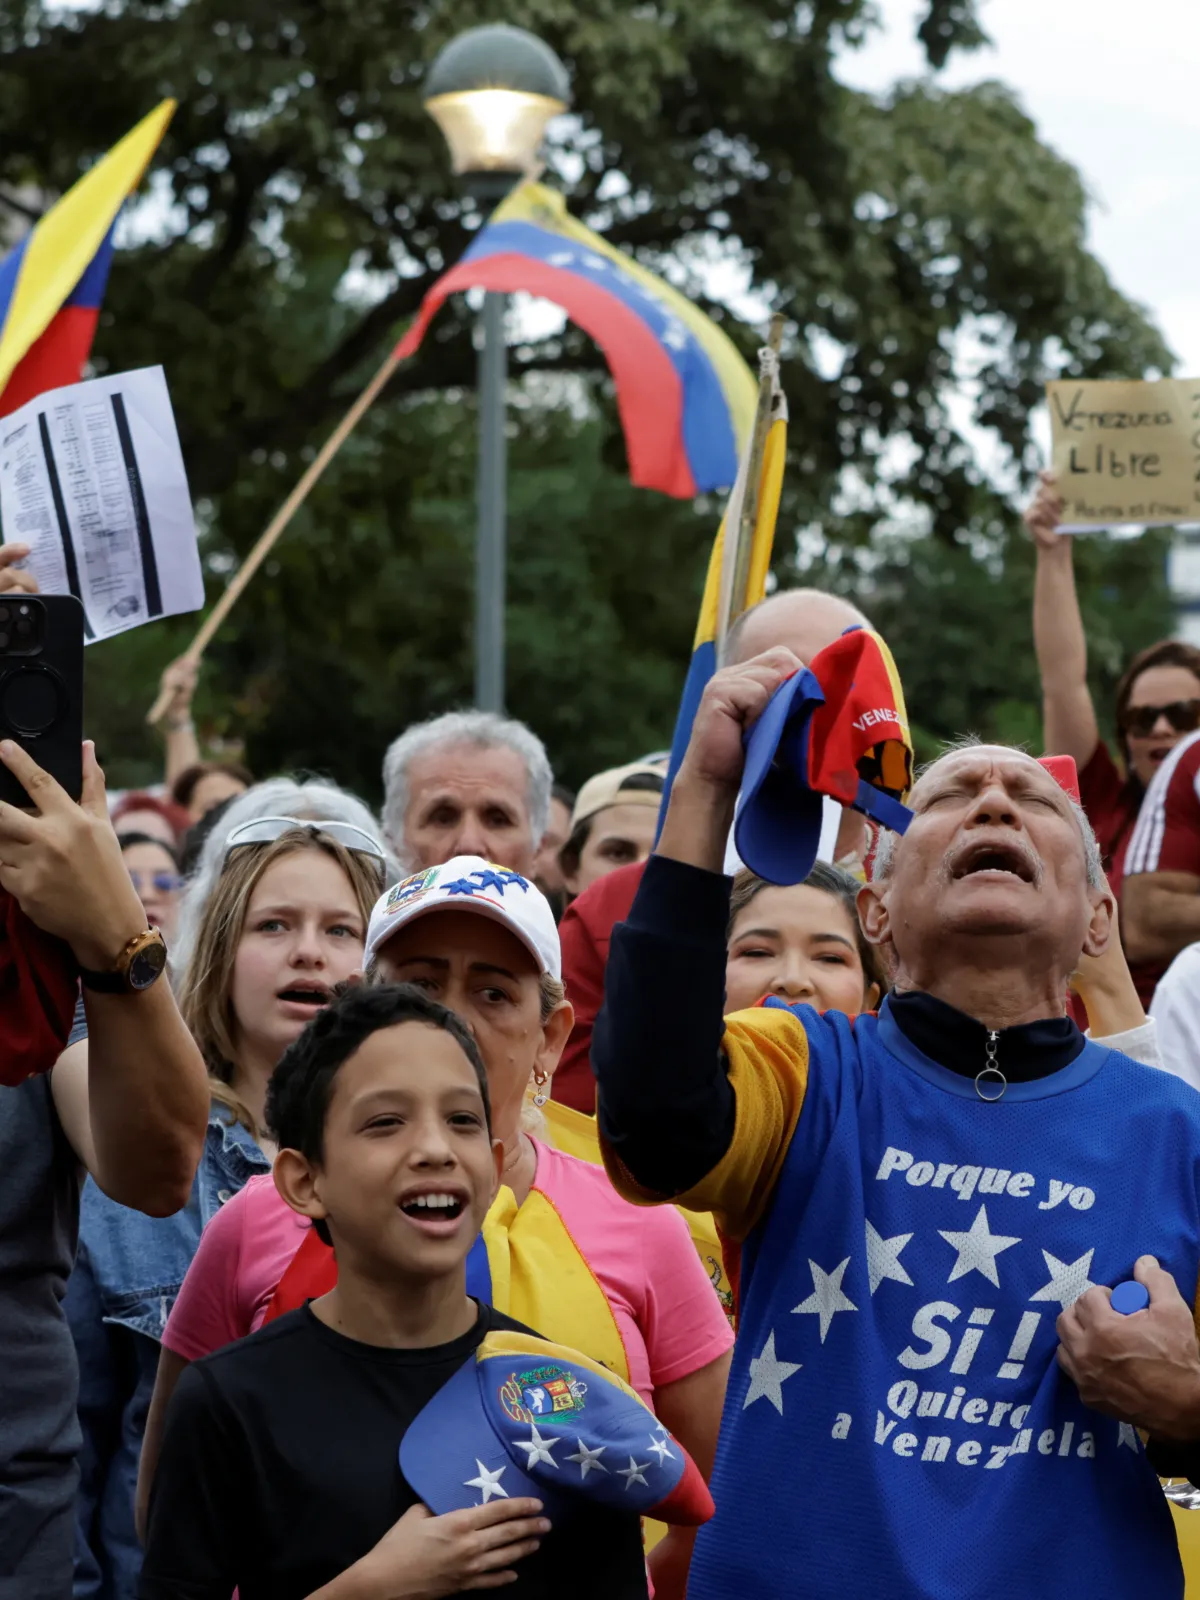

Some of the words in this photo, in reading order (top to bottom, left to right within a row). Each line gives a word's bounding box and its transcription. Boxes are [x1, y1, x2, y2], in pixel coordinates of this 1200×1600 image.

[875, 1146, 1036, 1201] Porque
[1038, 1178, 1096, 1211] yo
[831, 1412, 852, 1439] a
